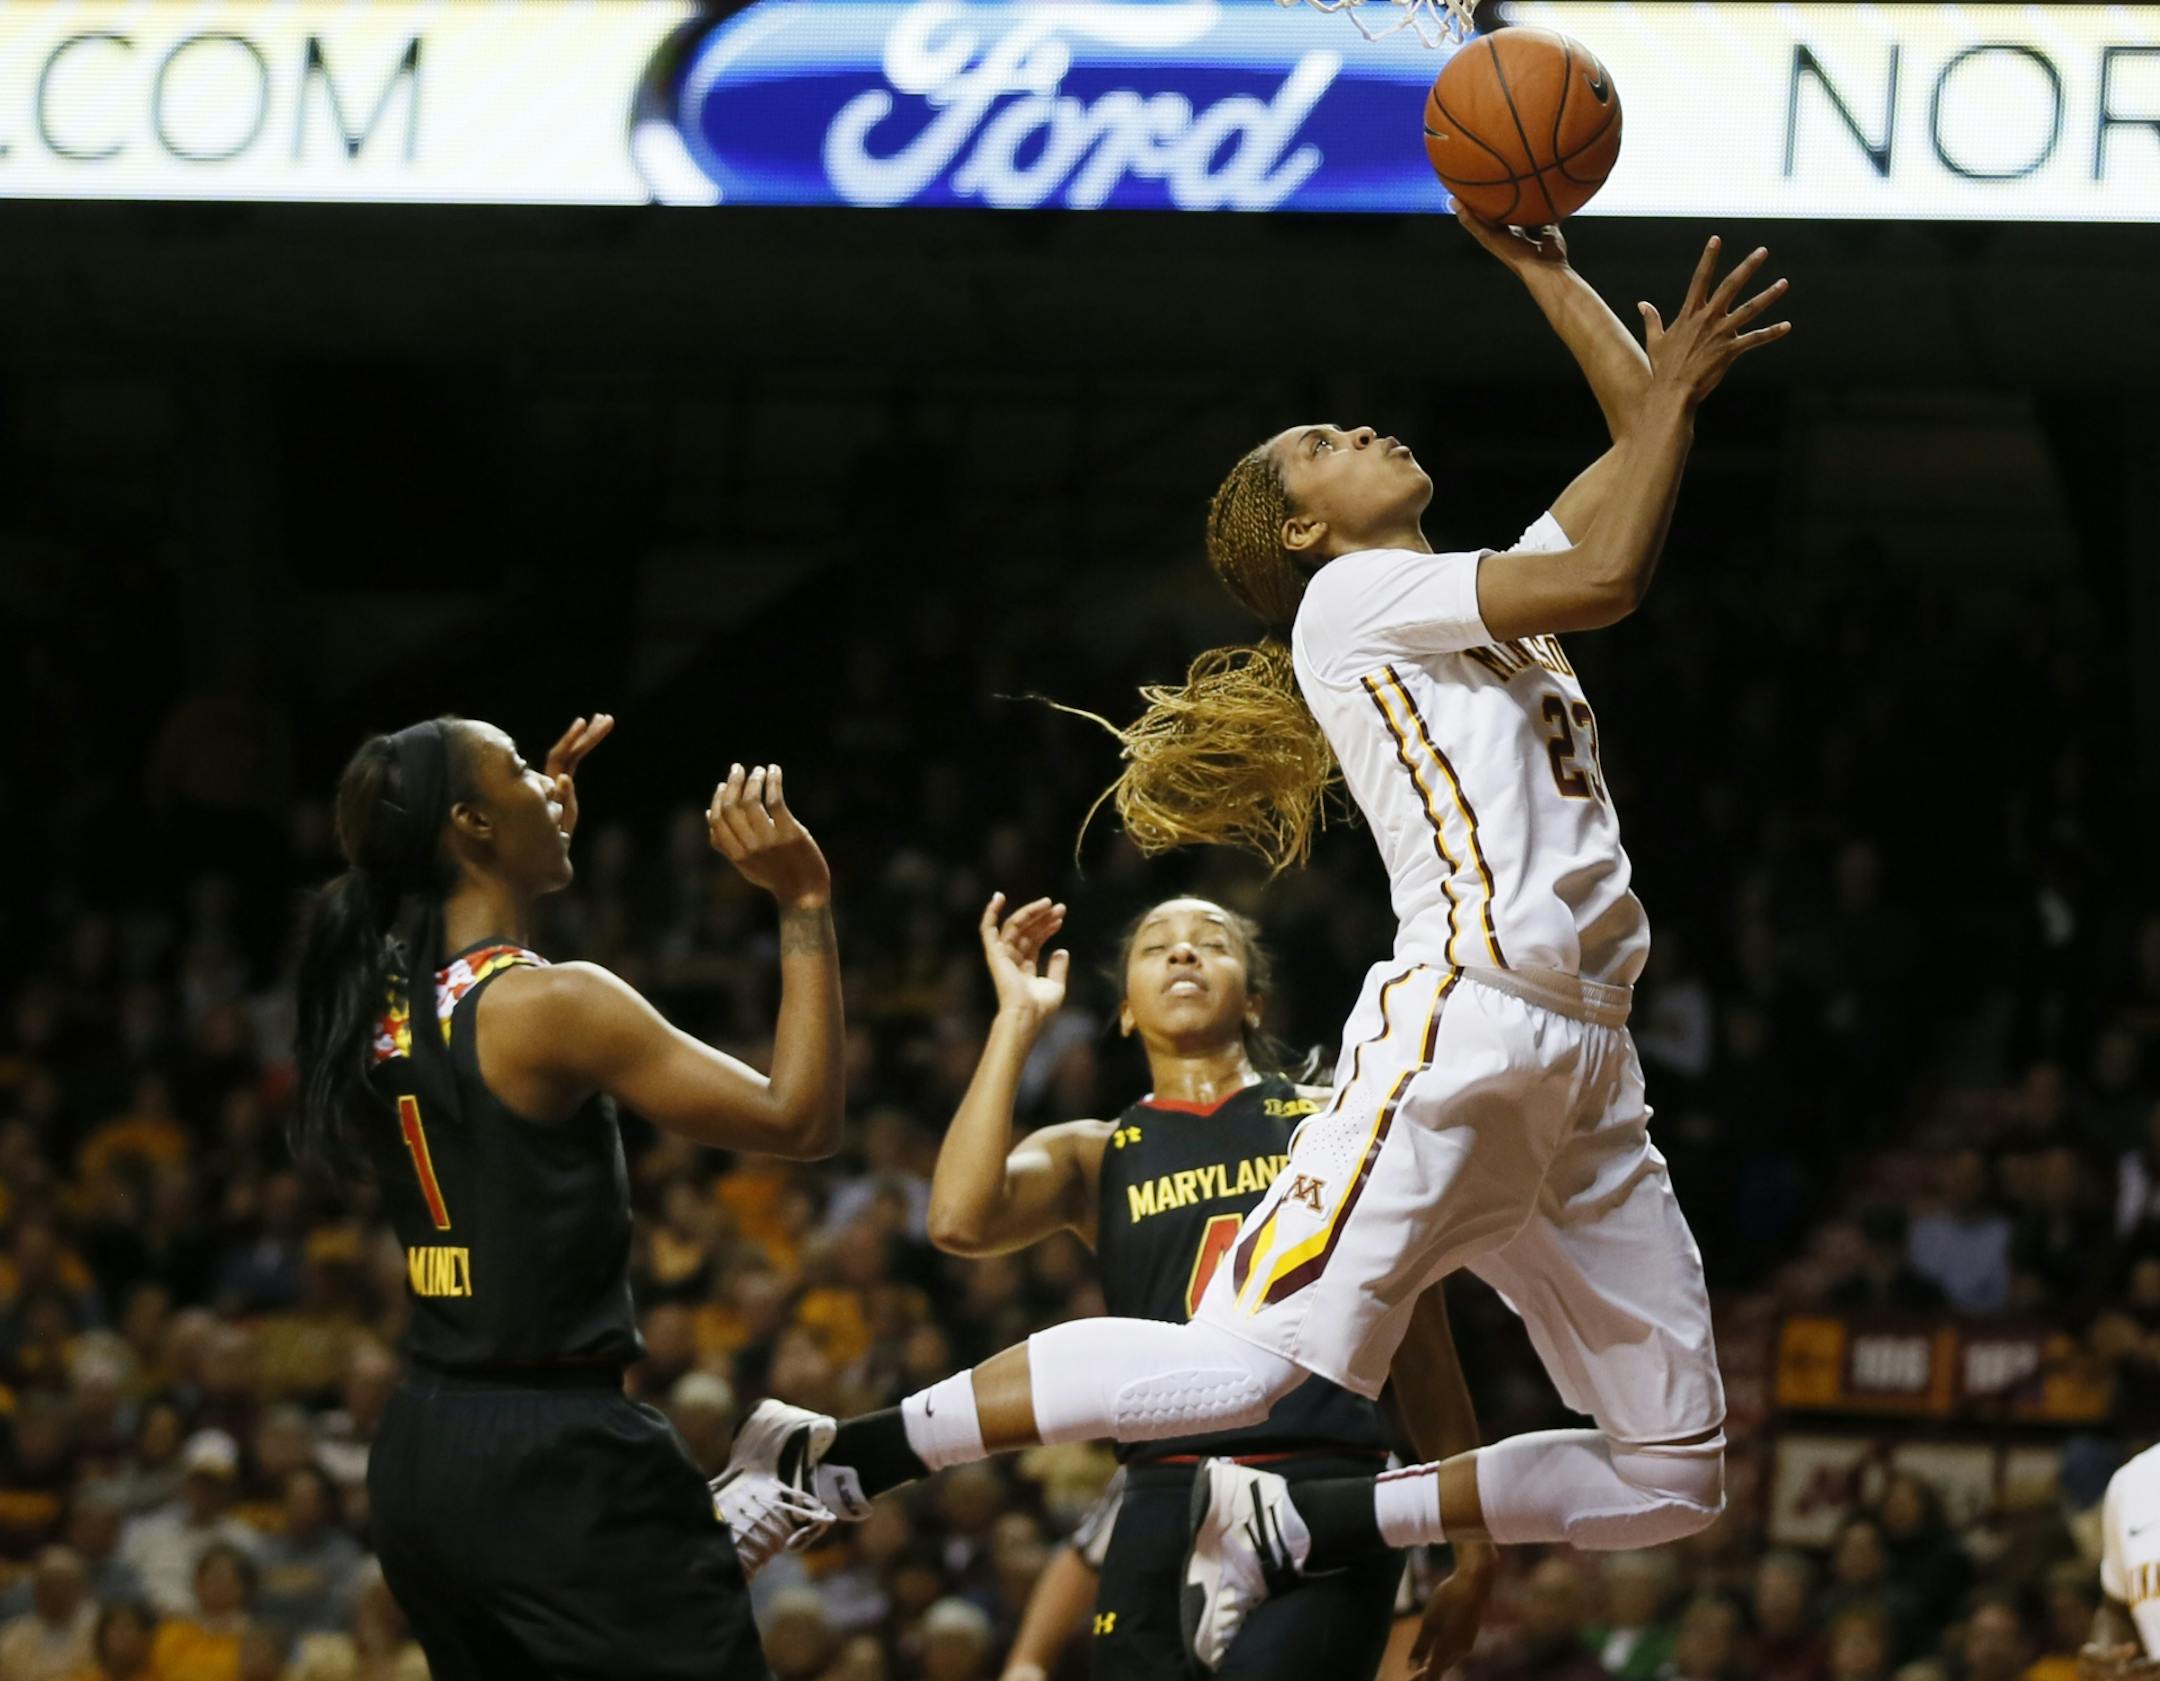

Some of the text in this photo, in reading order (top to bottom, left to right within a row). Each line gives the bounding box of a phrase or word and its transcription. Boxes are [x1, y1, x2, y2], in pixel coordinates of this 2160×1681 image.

[821, 0, 1343, 211] Ford
[1541, 692, 1606, 806] 23
[398, 1095, 451, 1231] 1
